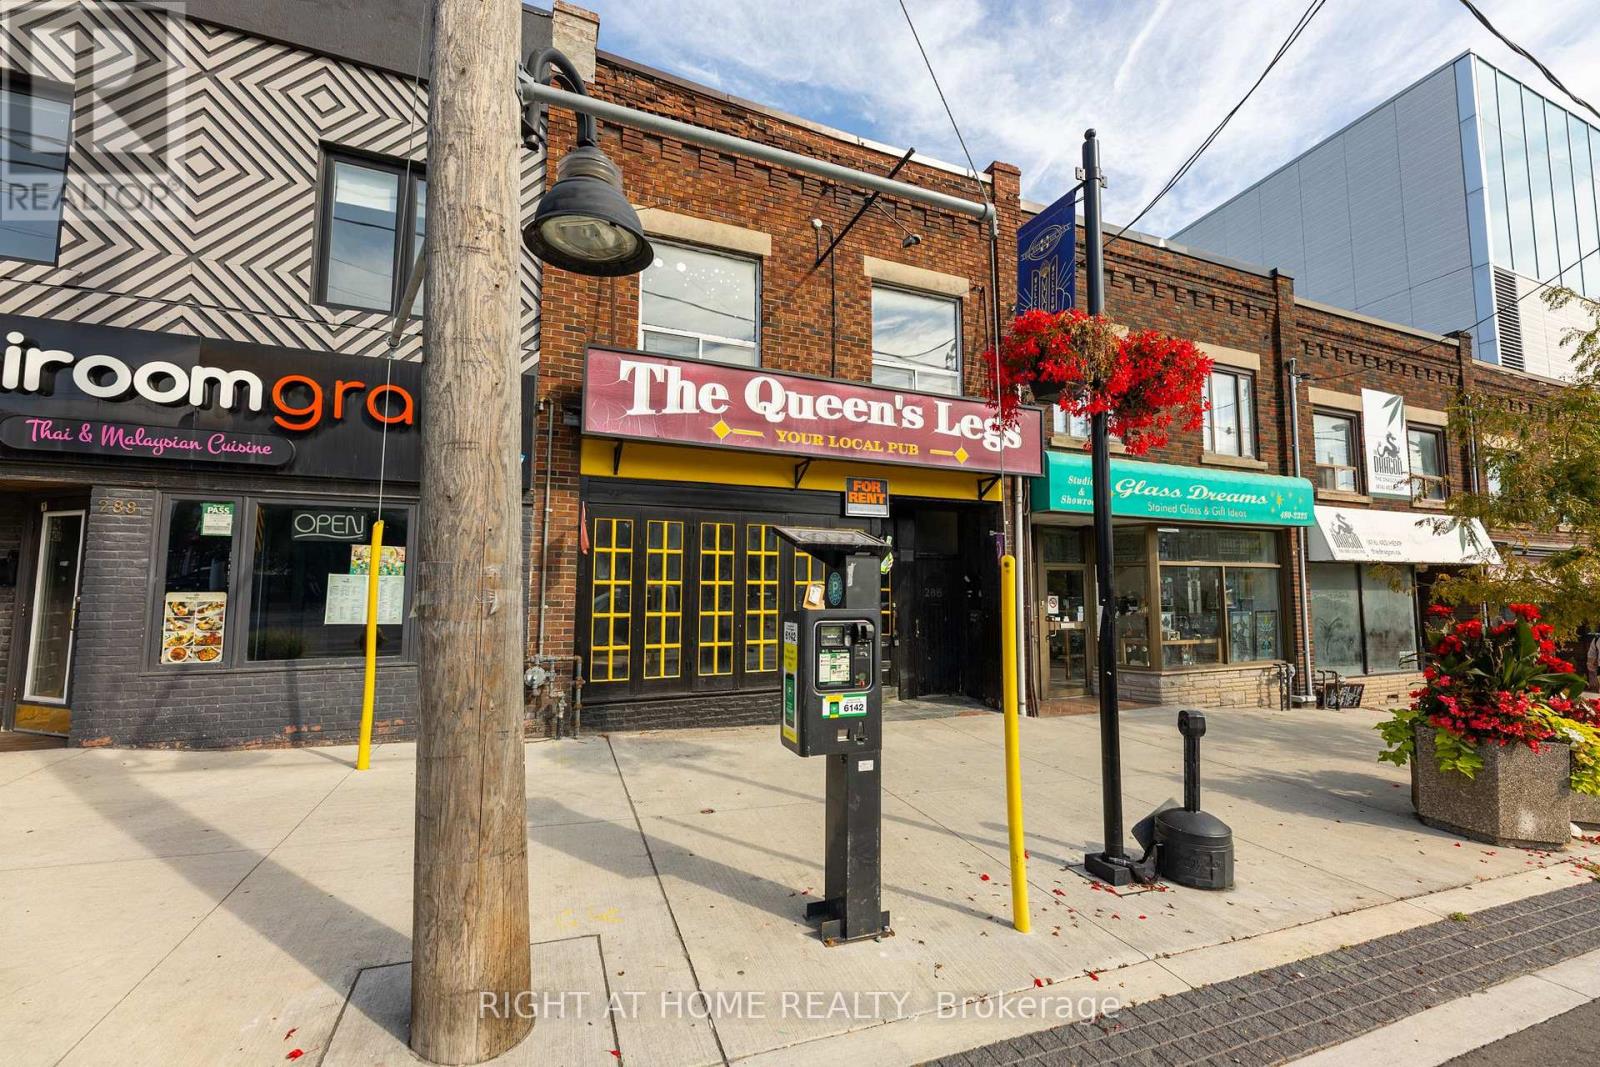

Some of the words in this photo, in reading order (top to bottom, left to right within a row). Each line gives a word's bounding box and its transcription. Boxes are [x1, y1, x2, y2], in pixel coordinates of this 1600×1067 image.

[620, 359, 729, 415] The
[744, 376, 924, 429] Queen's
[934, 400, 1022, 452] Legs
[25, 418, 73, 442] Thai
[79, 423, 93, 442] &
[100, 425, 202, 455] Malaysian
[208, 433, 272, 455] Cuisine
[775, 429, 824, 446] YOUR
[828, 435, 883, 453] LOCAL
[888, 442, 919, 455] PUB
[1373, 455, 1403, 475] DRAGON
[853, 480, 880, 492] FOR
[1078, 487, 1085, 496] &
[1115, 478, 1182, 499] Glass
[1187, 485, 1267, 504] Dreams
[848, 492, 885, 504] RENT
[1061, 495, 1094, 505] Showro
[98, 500, 136, 514] 288
[207, 506, 230, 515] PASS
[1147, 502, 1177, 513] Stained
[1180, 504, 1201, 515] Glass
[1204, 506, 1210, 516] &
[1212, 506, 1225, 516] Gift
[1228, 508, 1247, 518] Ideas
[294, 513, 364, 534] OPEN
[843, 703, 864, 712] 6142
